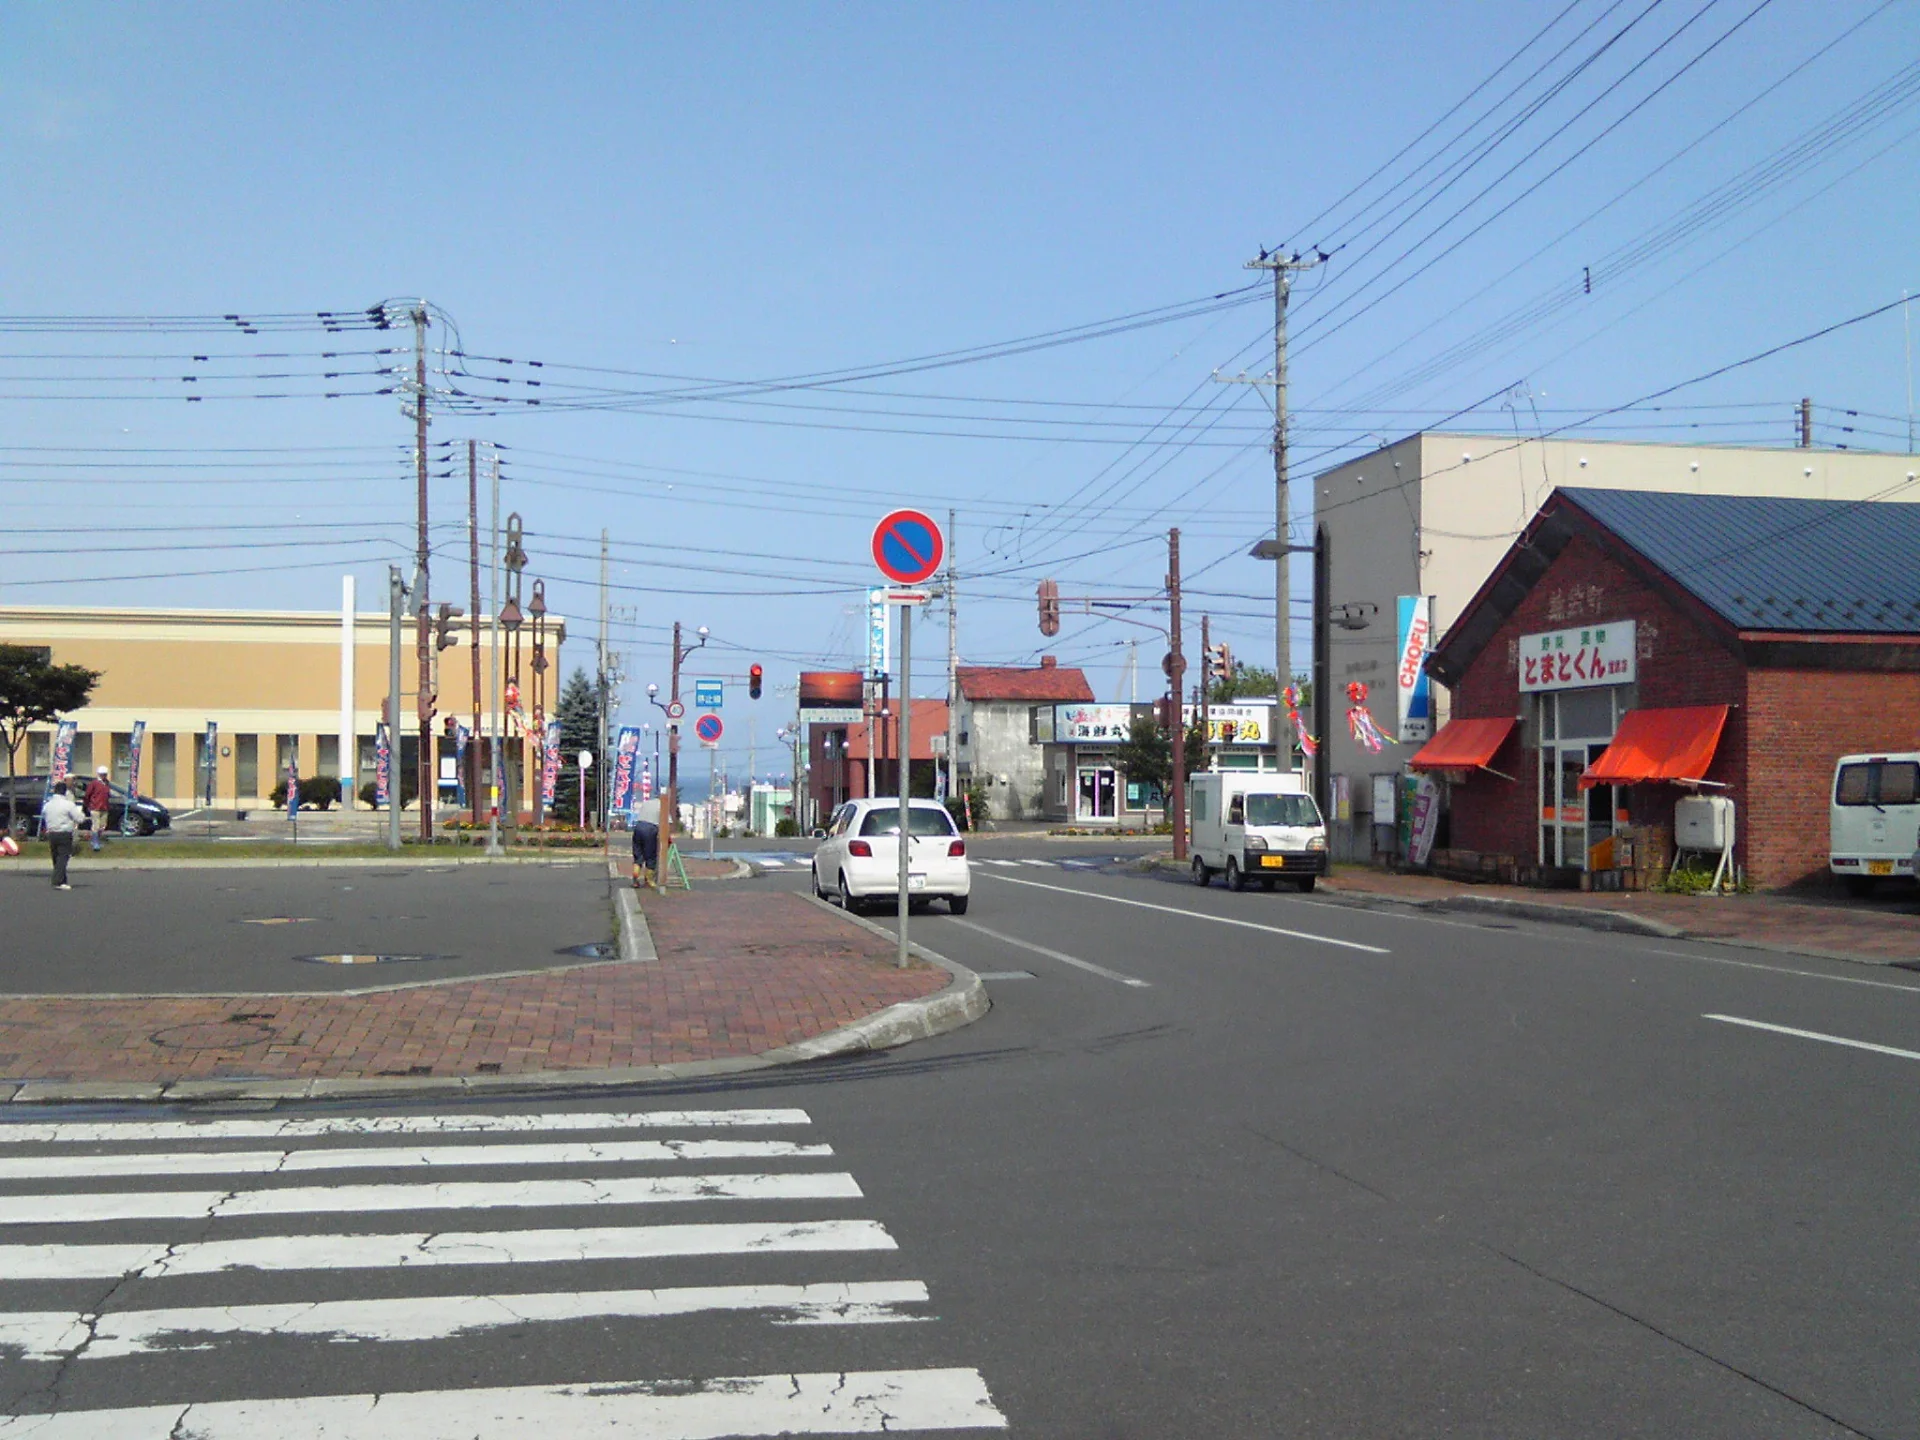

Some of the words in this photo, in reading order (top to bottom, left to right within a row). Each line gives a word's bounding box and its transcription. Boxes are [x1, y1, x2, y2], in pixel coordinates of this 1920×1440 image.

[1400, 618, 1428, 688] CHOFU
[1525, 646, 1606, 685] とまとくん
[1078, 724, 1125, 737] 海鮮丸
